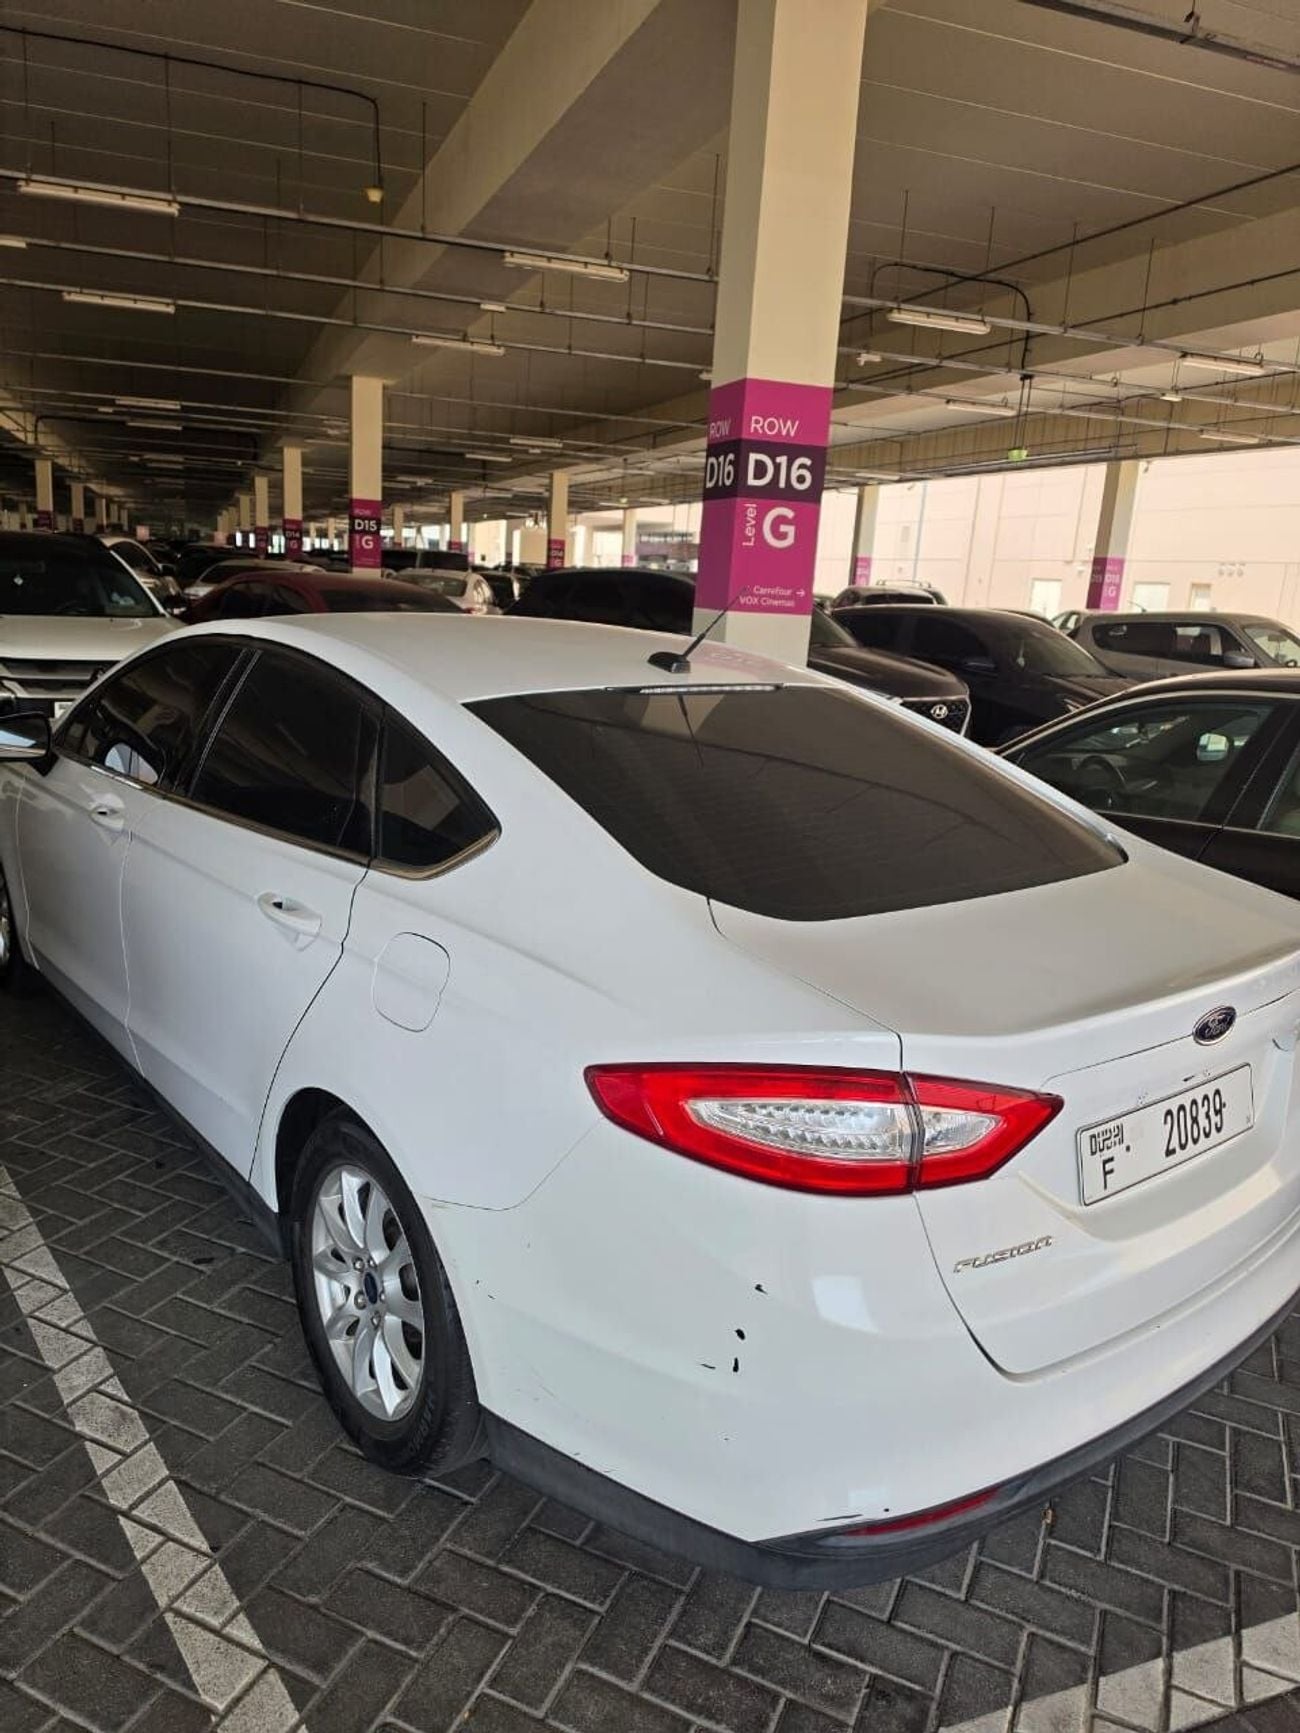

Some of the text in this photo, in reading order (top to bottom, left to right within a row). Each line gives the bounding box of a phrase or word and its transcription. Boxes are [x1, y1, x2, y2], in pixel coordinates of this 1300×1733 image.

[709, 420, 731, 439] ROW
[750, 415, 799, 437] ROW
[705, 453, 735, 488] D16
[747, 452, 812, 490] D16
[354, 519, 377, 531] D15
[361, 535, 374, 549] G
[742, 503, 757, 546] Level
[762, 506, 796, 549] G
[739, 595, 759, 605] VOX
[753, 585, 792, 596] Carrefour
[1163, 1088, 1223, 1158] 20839
[1102, 1156, 1115, 1191] F
[953, 1235, 1053, 1273] FUSION
